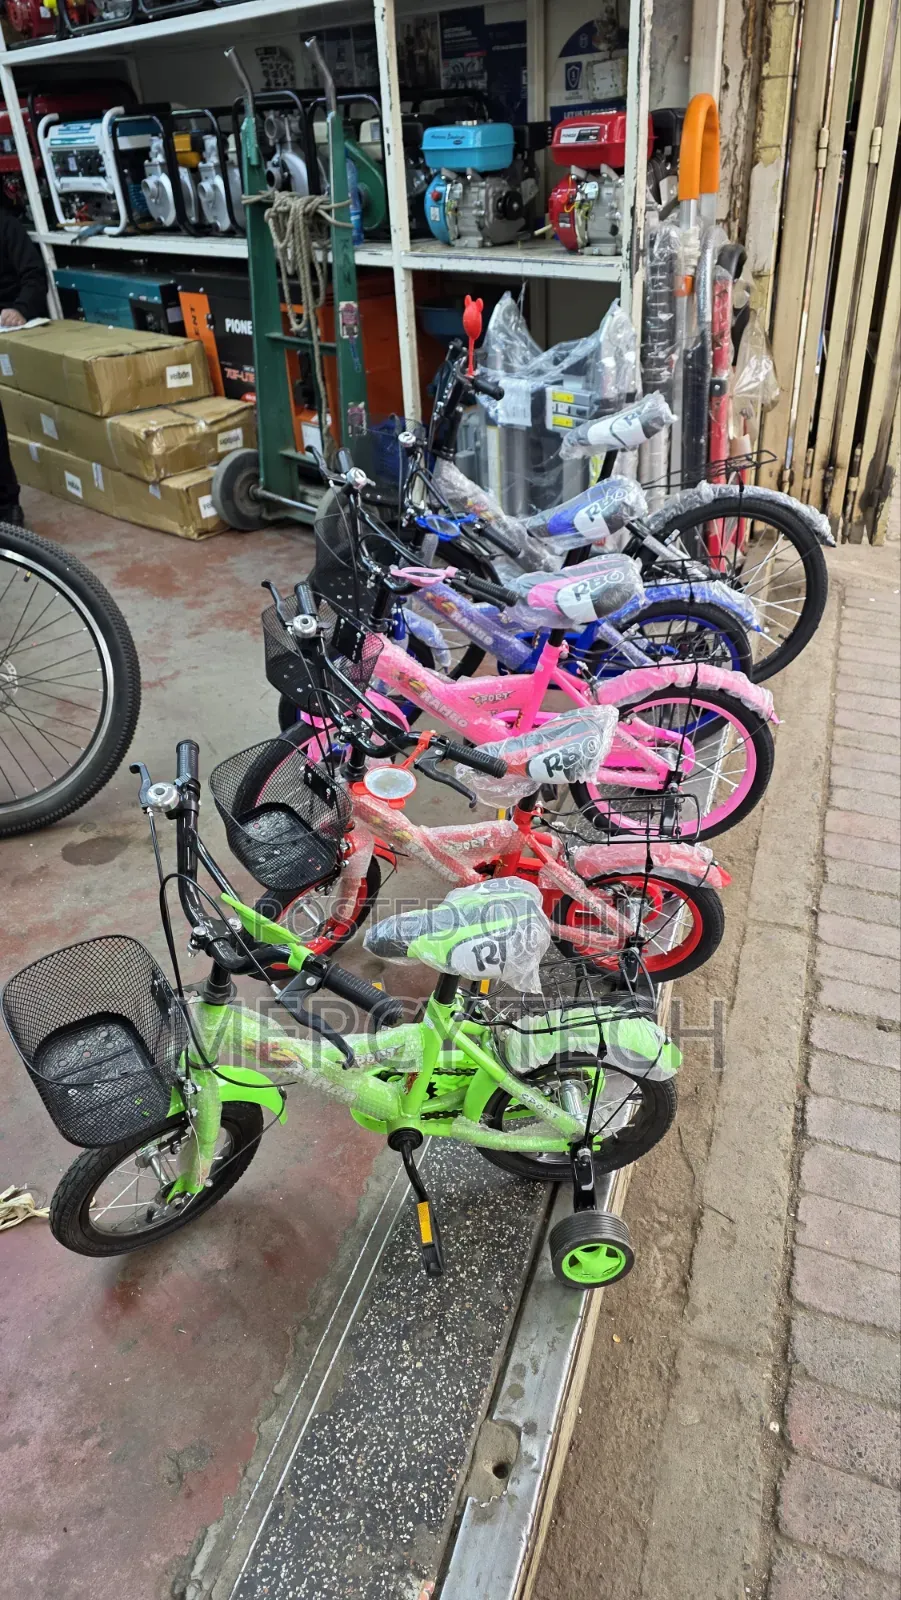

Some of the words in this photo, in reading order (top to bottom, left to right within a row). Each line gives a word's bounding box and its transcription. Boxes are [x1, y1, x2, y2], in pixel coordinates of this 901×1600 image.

[450, 611, 495, 646] RAMBO
[420, 690, 469, 729] RAMBO
[474, 691, 513, 706] SPORT
[353, 1046, 399, 1067] PORT
